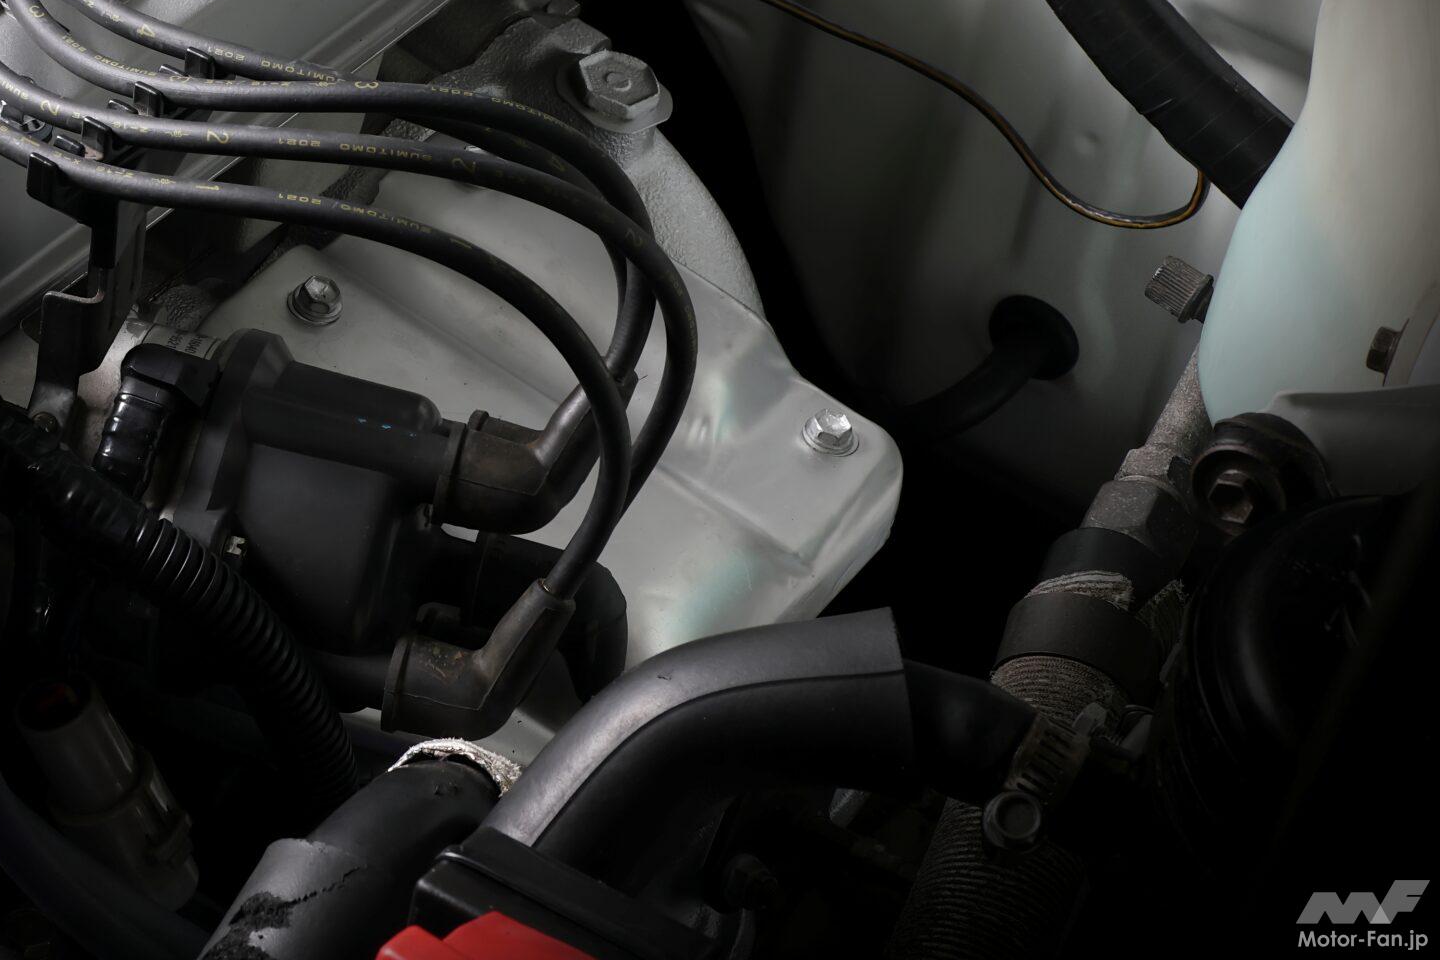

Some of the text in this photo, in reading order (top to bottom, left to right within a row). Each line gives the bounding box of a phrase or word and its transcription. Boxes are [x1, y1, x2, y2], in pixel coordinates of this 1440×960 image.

[40, 99, 60, 116] 2
[207, 130, 230, 144] 2
[340, 143, 433, 162] SUMITOMO
